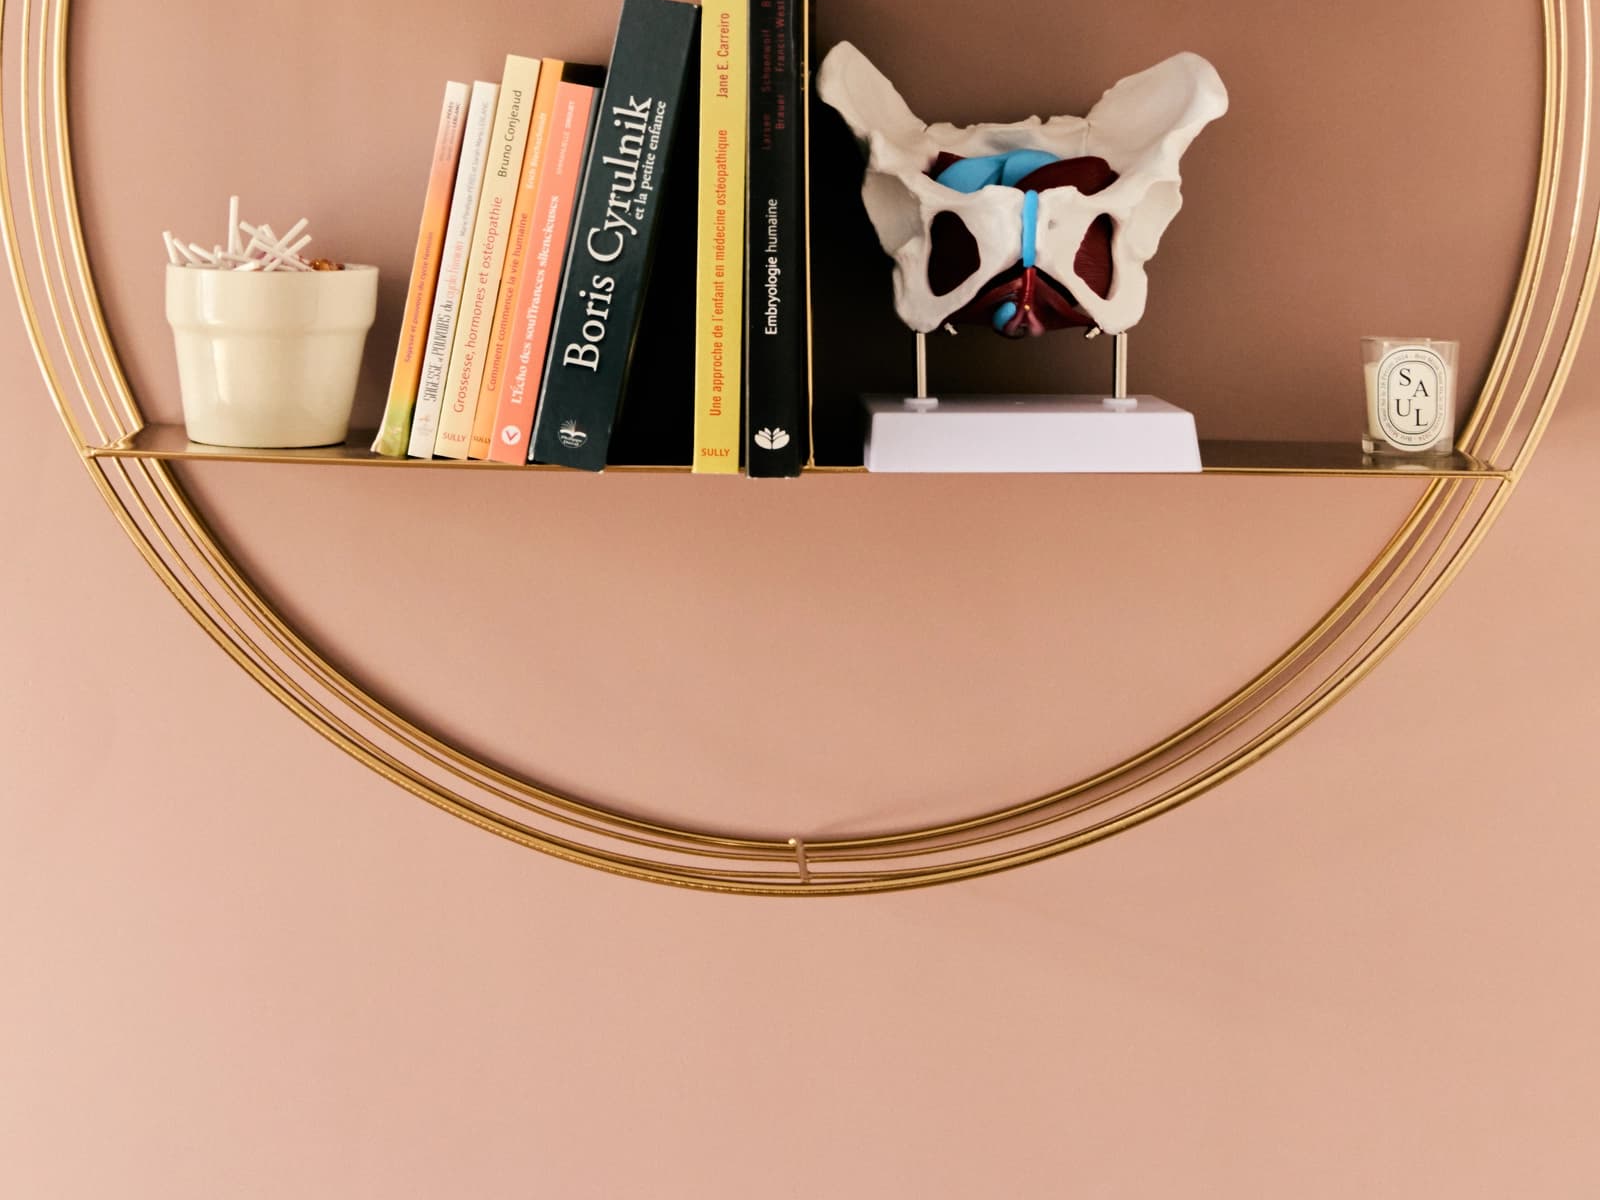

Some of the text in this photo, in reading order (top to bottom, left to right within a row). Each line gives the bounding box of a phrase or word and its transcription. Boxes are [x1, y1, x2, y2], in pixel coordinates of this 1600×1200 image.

[716, 13, 730, 98] Jane E. Carreiro
[775, 1, 785, 129] Brauer Francis-West
[497, 90, 522, 177] Bruno Conjeaud
[633, 101, 666, 220] et la petite enfance
[763, 114, 771, 150] Larsen
[520, 343, 531, 364] des
[526, 270, 544, 340] souffrances
[538, 196, 558, 266] silencieuses
[564, 98, 654, 370] Boris Cyrulnik
[709, 130, 728, 416] Une approche de l'enfant en médecine ostéopathique
[765, 199, 781, 335] Embryologie humaine
[432, 314, 450, 356] POUVOIRS
[454, 197, 502, 413] Grossesse, hormones et ostéopathie
[488, 213, 528, 391] Comment commence la vie humaine
[424, 365, 442, 402] SAGESSE
[442, 432, 466, 442] SULLY
[701, 448, 730, 457] SULLY
